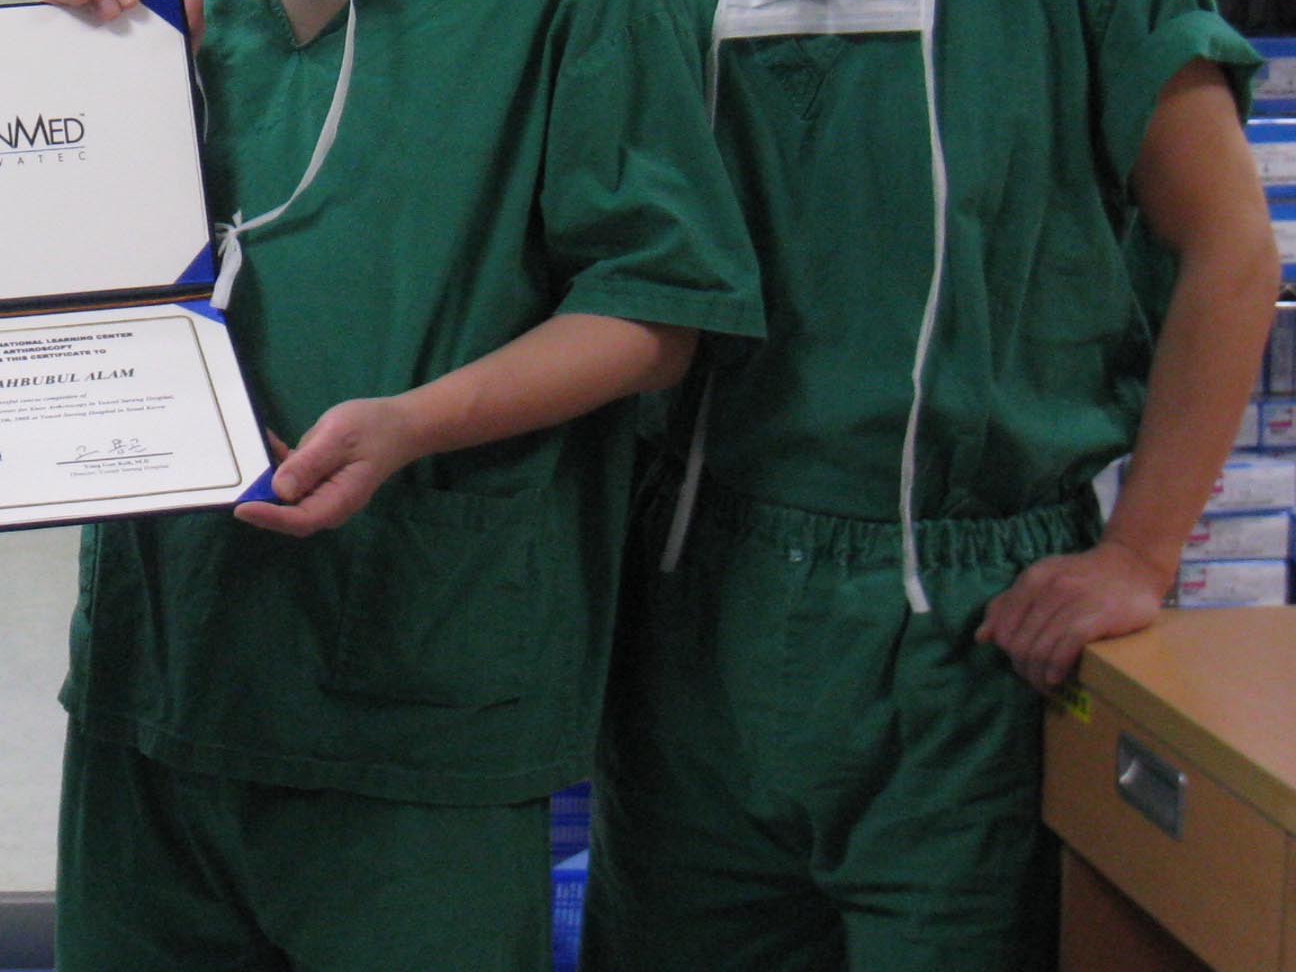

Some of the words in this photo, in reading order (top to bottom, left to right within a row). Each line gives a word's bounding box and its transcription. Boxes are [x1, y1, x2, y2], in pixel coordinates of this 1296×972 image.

[46, 334, 94, 344] LEARNING
[96, 332, 133, 340] CENTER
[84, 367, 136, 382] ALAM
